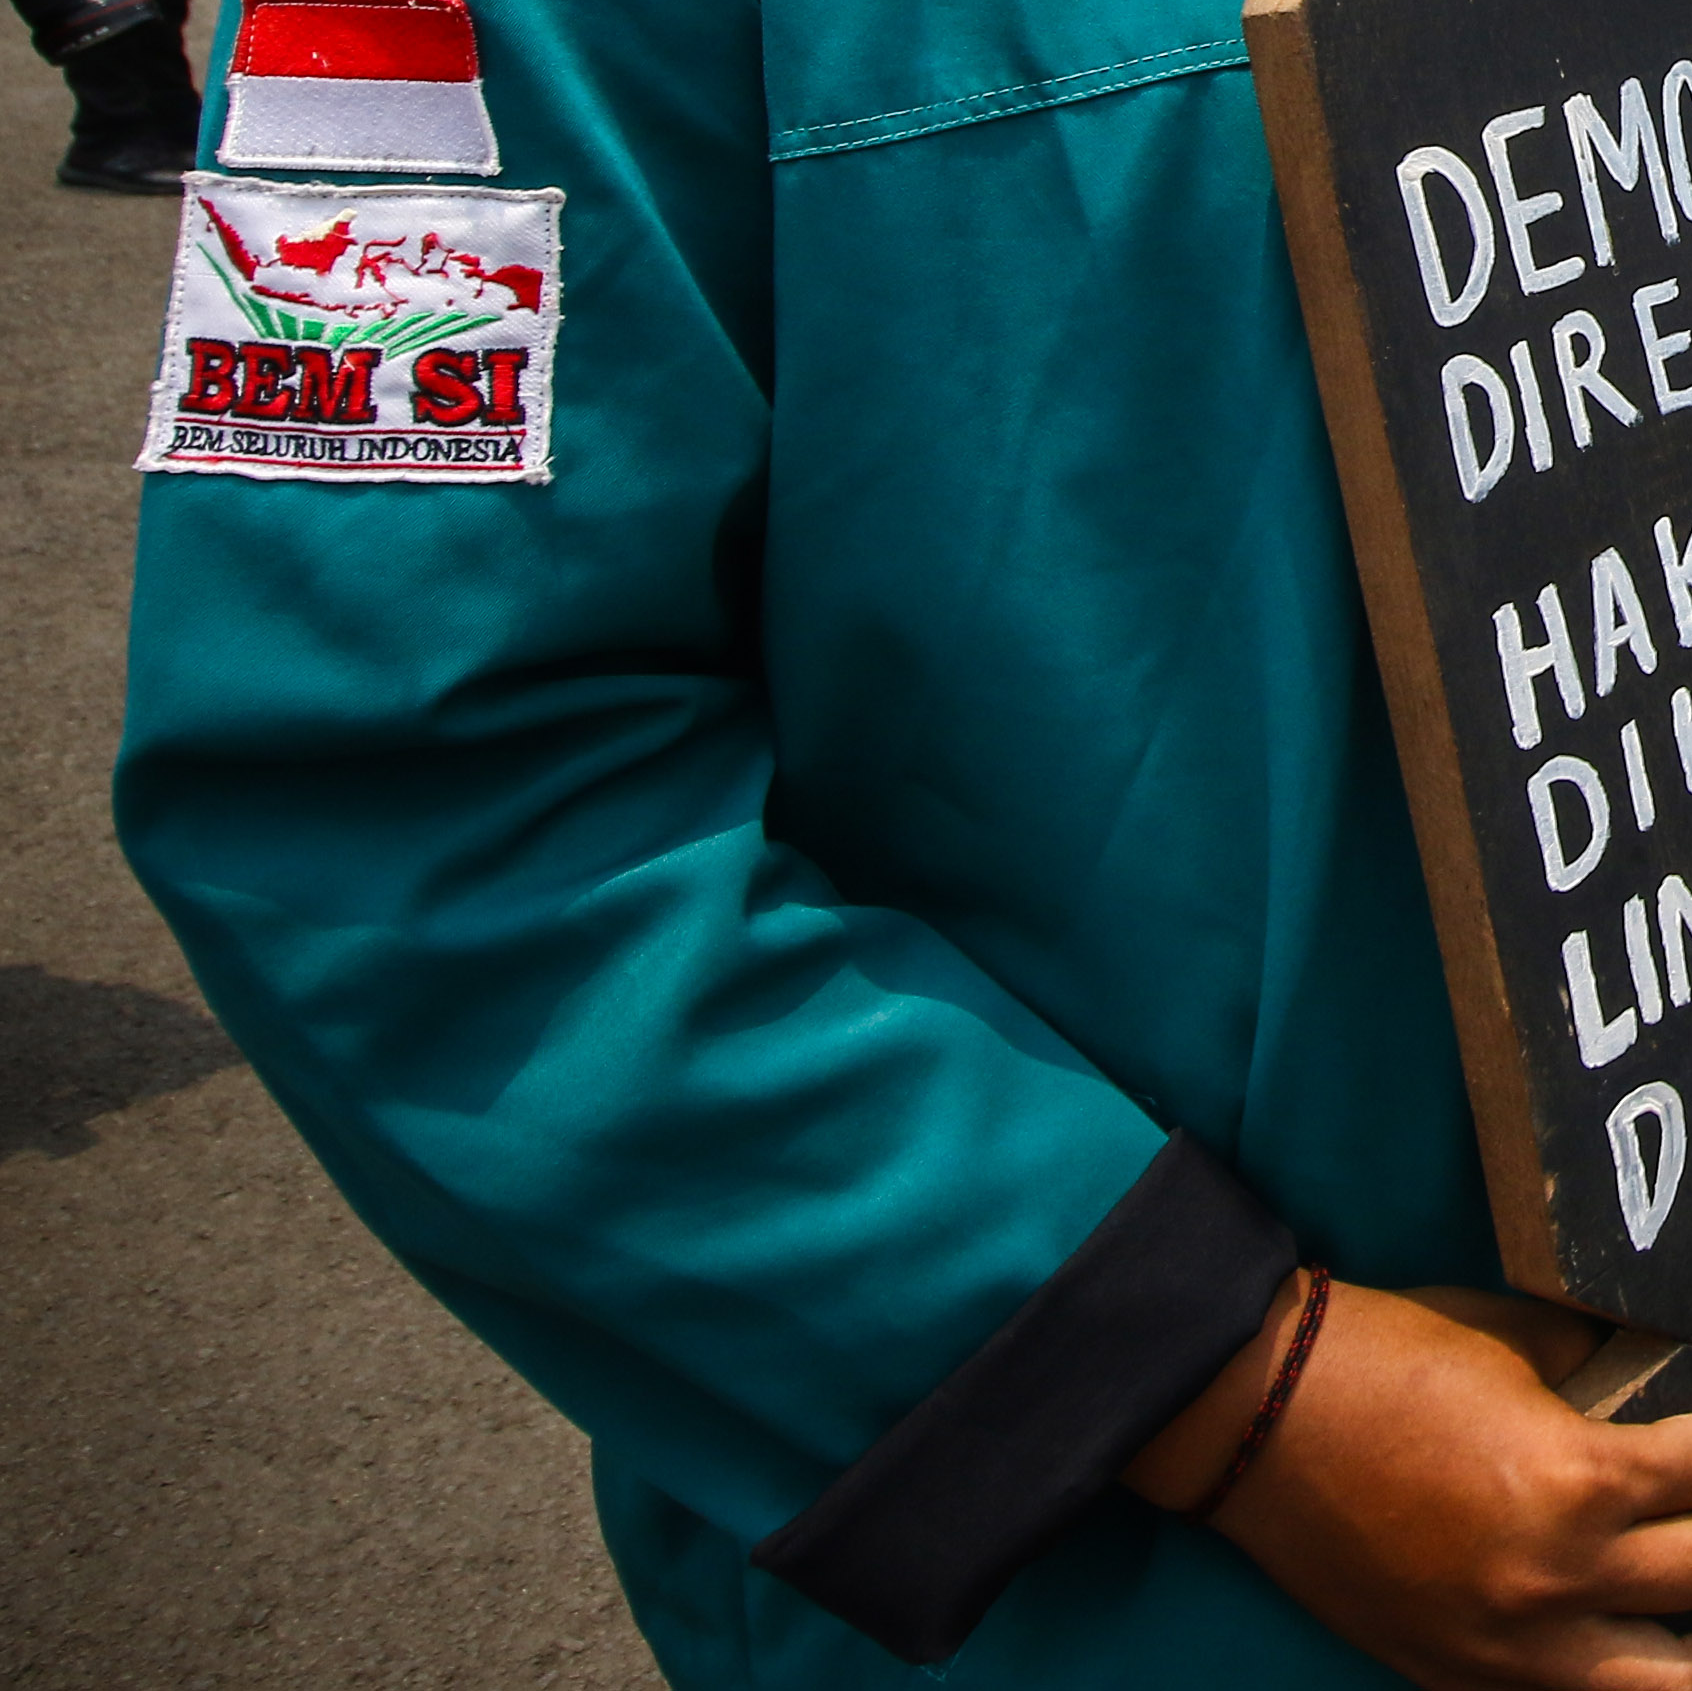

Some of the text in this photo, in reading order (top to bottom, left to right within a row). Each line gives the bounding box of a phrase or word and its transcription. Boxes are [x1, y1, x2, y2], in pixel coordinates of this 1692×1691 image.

[178, 336, 529, 428] BEM SI
[168, 425, 524, 464] BEM SELURUH INDONESIA
